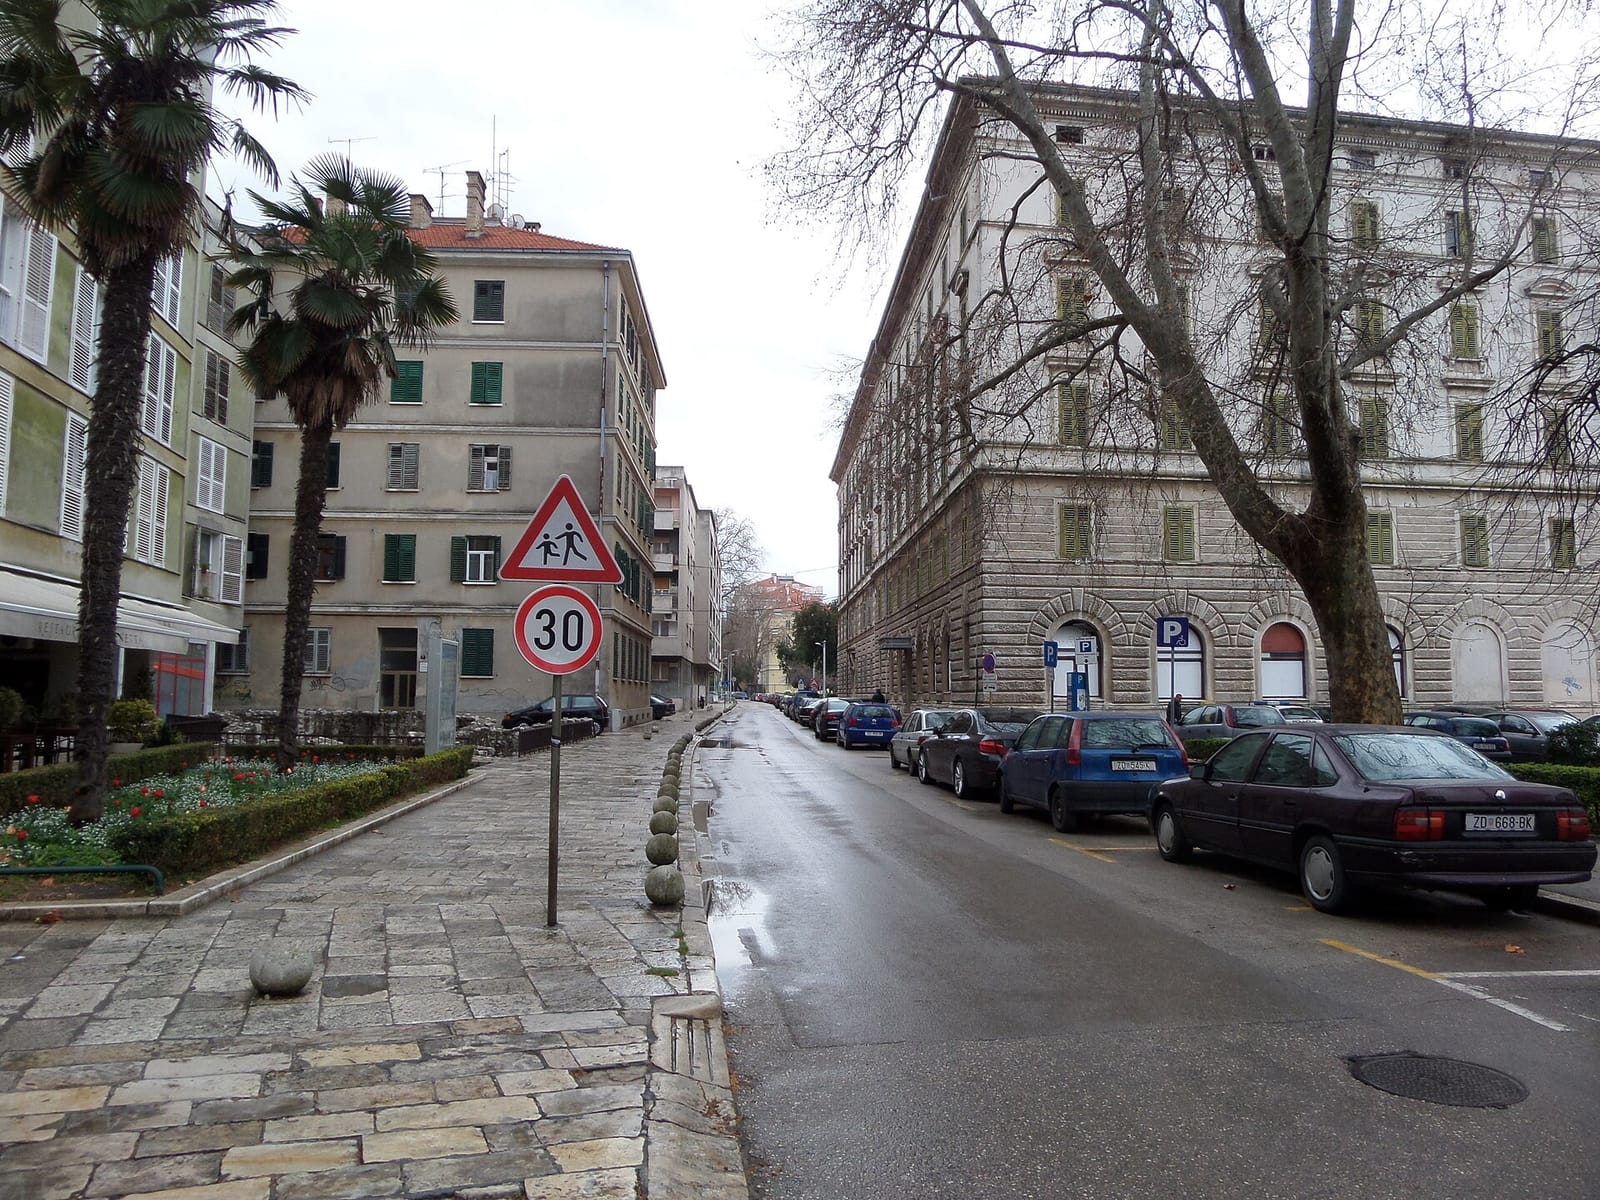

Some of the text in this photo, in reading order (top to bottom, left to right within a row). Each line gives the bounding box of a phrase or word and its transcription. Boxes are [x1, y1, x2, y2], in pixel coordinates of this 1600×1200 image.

[533, 608, 584, 652] 30
[1163, 620, 1182, 644] P
[1047, 645, 1054, 662] P
[1082, 642, 1090, 652] P
[1077, 674, 1084, 684] P
[1473, 816, 1532, 829] ZD 668-BK
